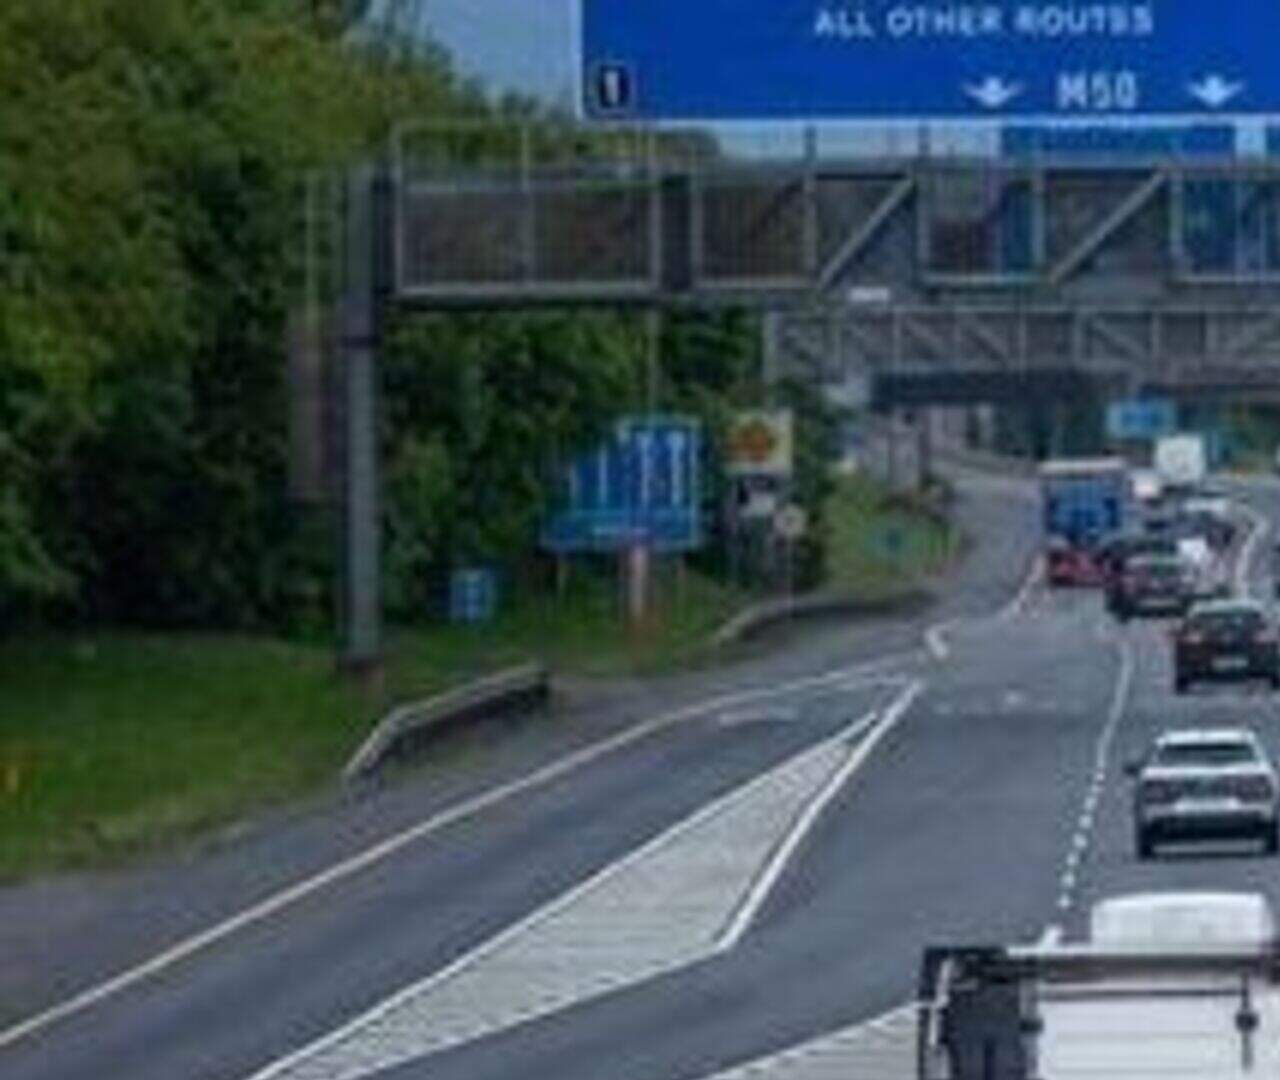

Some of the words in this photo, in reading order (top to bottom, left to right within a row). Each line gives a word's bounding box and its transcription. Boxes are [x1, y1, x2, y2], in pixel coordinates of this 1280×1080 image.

[814, 8, 875, 39] ALL
[885, 6, 1000, 38] OTHER
[1014, 4, 1154, 37] ROUTES
[1057, 71, 1138, 109] M50
